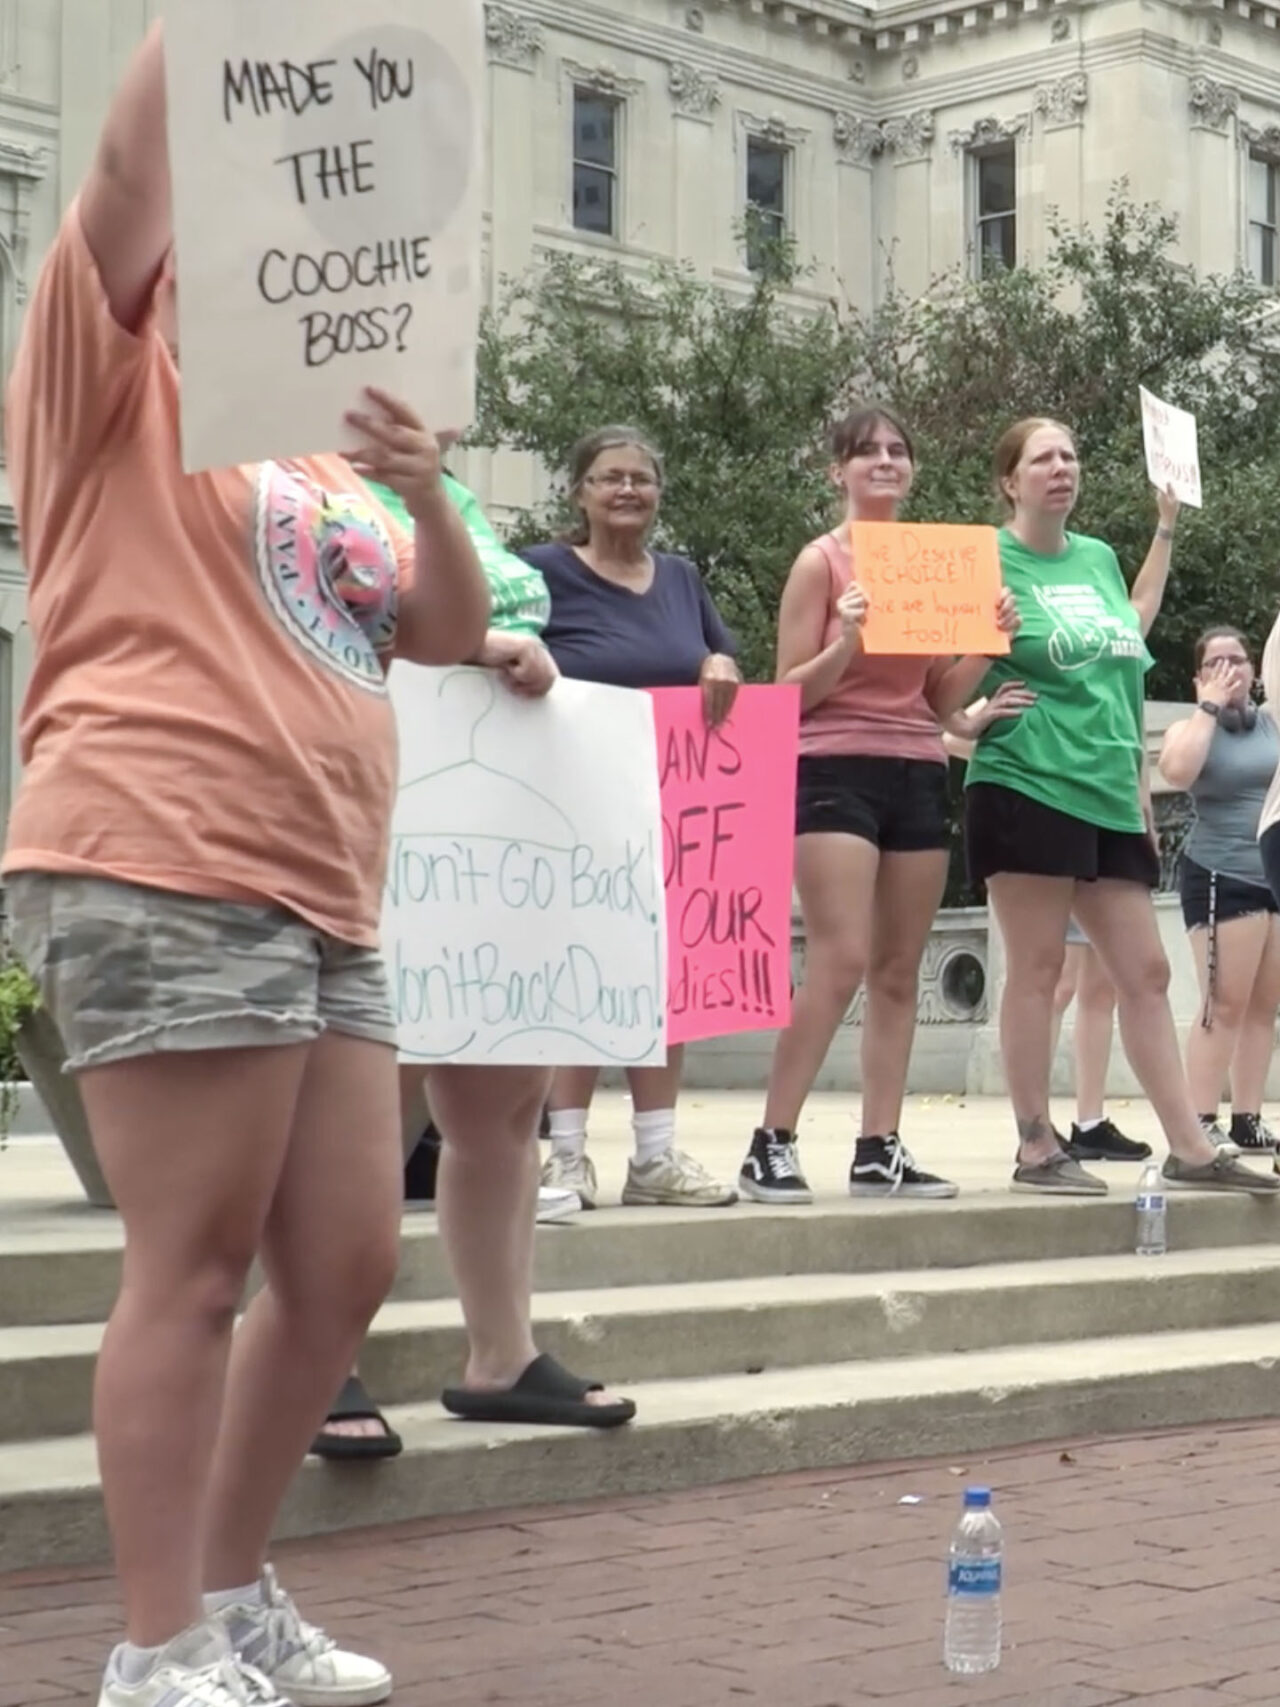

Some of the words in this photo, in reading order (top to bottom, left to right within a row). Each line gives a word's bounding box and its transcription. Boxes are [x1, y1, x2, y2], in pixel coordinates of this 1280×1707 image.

[222, 58, 338, 123] MADE
[353, 47, 414, 110] YOU
[273, 139, 375, 205] THE
[257, 235, 432, 303] COOCHIE
[299, 302, 414, 367] BOSS?
[660, 719, 743, 789] ANS
[498, 841, 555, 910] Go
[396, 938, 483, 1025] on't
